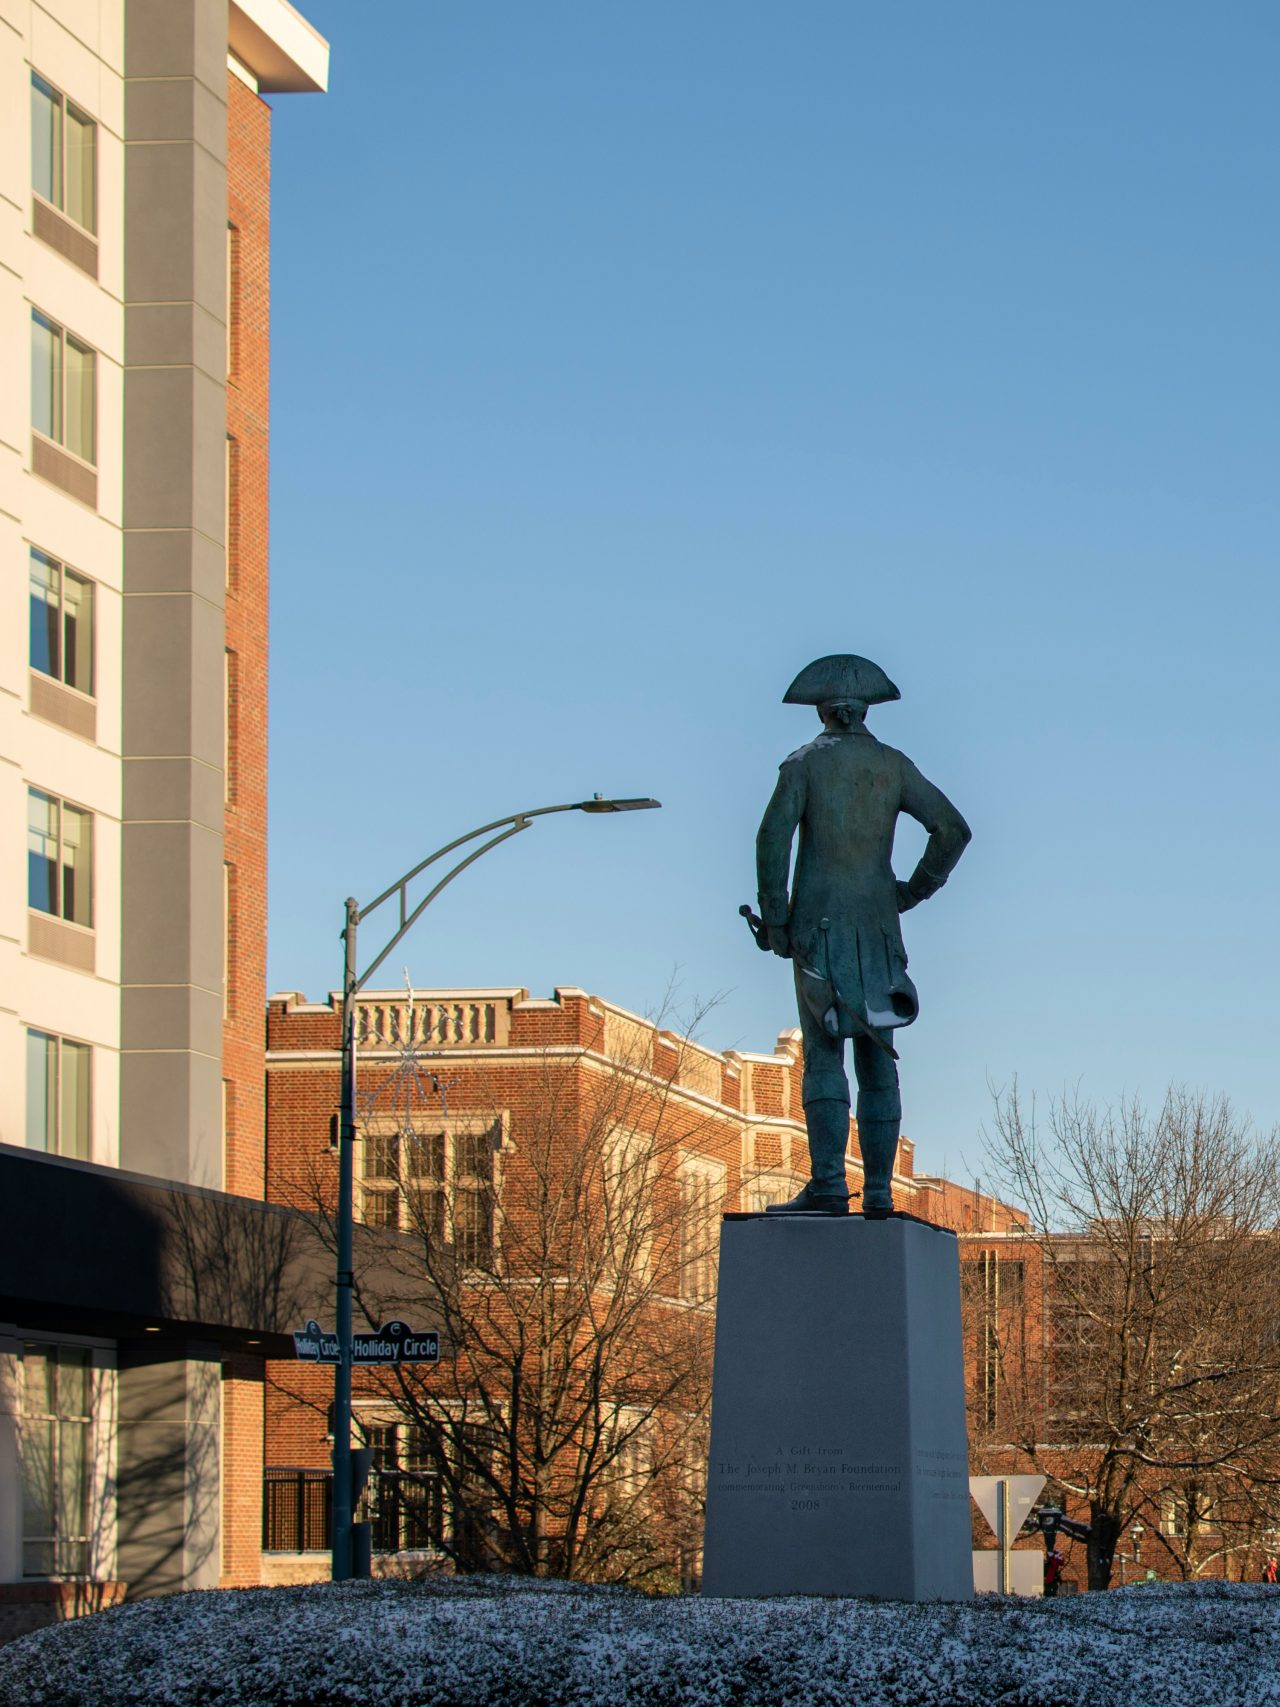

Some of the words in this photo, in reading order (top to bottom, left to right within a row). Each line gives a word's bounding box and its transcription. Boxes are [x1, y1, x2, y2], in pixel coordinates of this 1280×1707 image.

[354, 1339, 400, 1360] Holliday
[403, 1338, 437, 1356] Circle
[776, 1447, 783, 1455] A
[790, 1446, 810, 1455] Gift
[818, 1447, 843, 1455] from
[718, 1463, 740, 1474] The
[745, 1463, 781, 1477] Joseph
[803, 1463, 836, 1476] Bryan
[841, 1462, 901, 1474] Foundation
[718, 1483, 785, 1494] commemorating
[848, 1481, 901, 1492] Bicentennial
[791, 1499, 821, 1511] 2008
